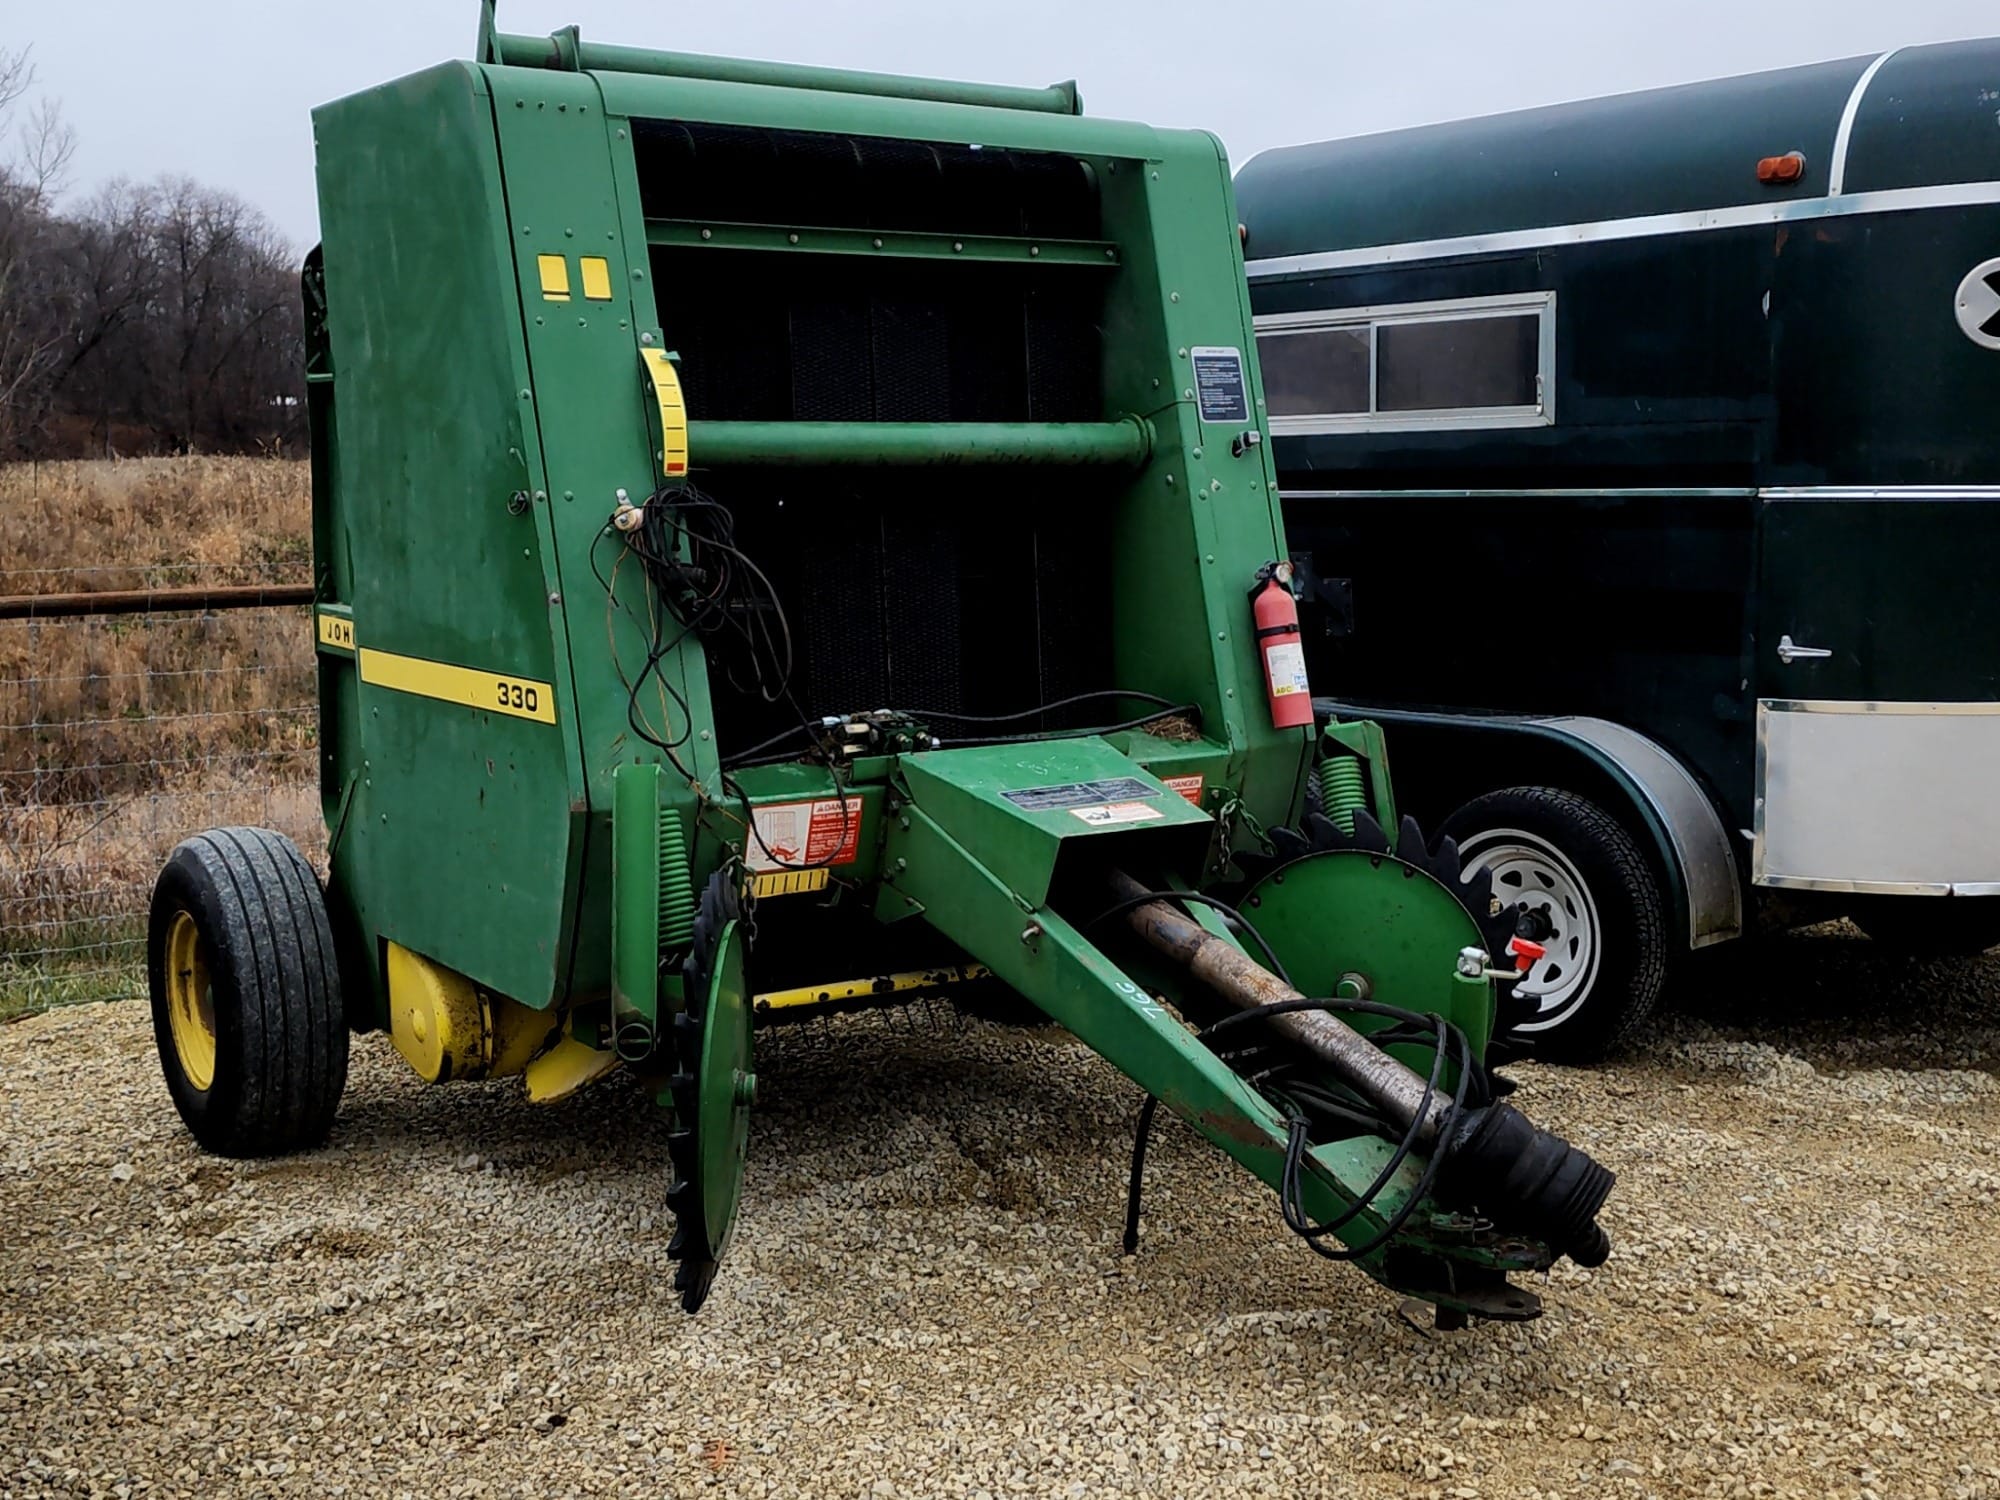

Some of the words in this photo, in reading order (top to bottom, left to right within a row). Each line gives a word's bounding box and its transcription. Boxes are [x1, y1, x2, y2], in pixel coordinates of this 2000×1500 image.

[327, 621, 355, 644] JOH
[496, 682, 538, 712] 330
[1171, 779, 1200, 789] DANGER
[824, 801, 858, 811] DANER
